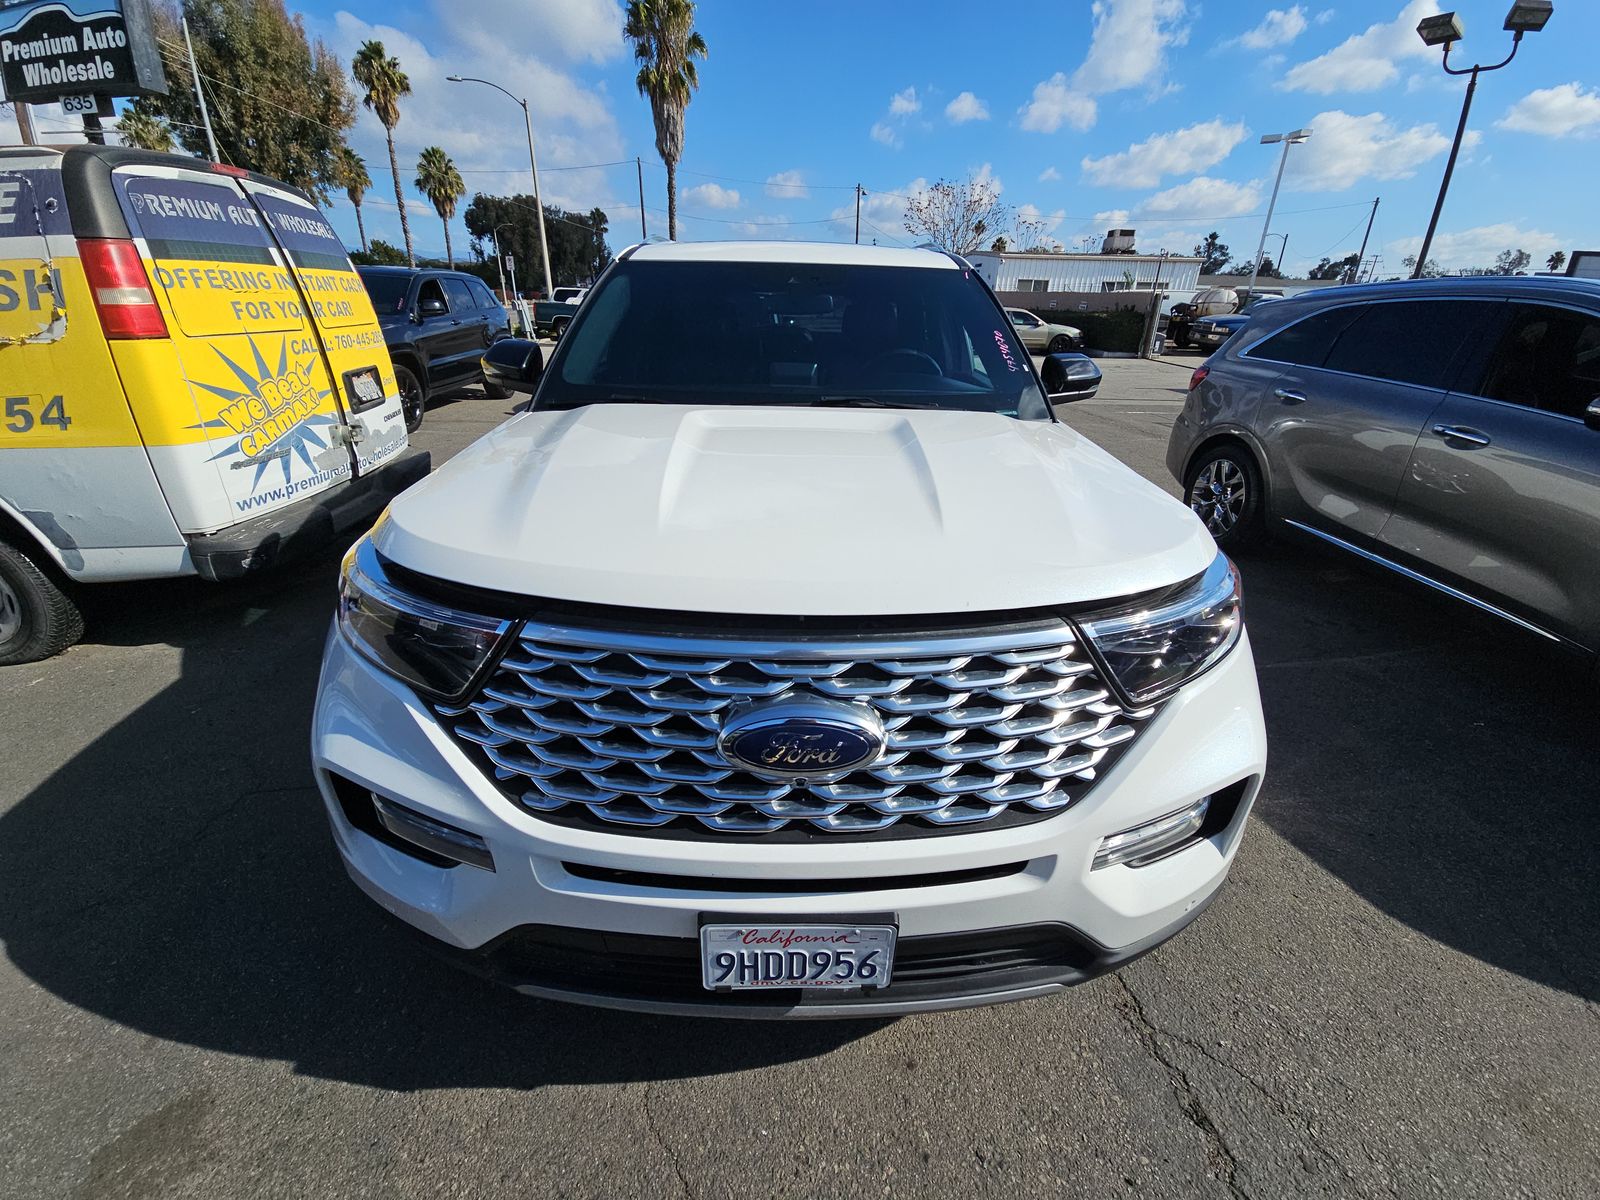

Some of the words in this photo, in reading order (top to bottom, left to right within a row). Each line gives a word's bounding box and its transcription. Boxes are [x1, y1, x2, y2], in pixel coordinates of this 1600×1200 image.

[1, 32, 78, 63] Premium
[82, 26, 126, 51] Auto
[22, 55, 115, 88] Wholesale
[63, 97, 93, 111] 635
[129, 192, 226, 222] PREMIUM
[275, 212, 335, 240] WHOLESALE
[153, 267, 271, 290] OFFERING
[341, 278, 366, 293] CASH
[230, 300, 275, 321] FOR
[326, 301, 354, 317] CAR!
[291, 336, 334, 355] CALL:
[218, 395, 267, 434] We
[257, 361, 311, 413] Beat
[5, 395, 71, 433] 54
[761, 732, 843, 764] Ford
[741, 929, 861, 948] California
[715, 951, 881, 982] 9HDD956
